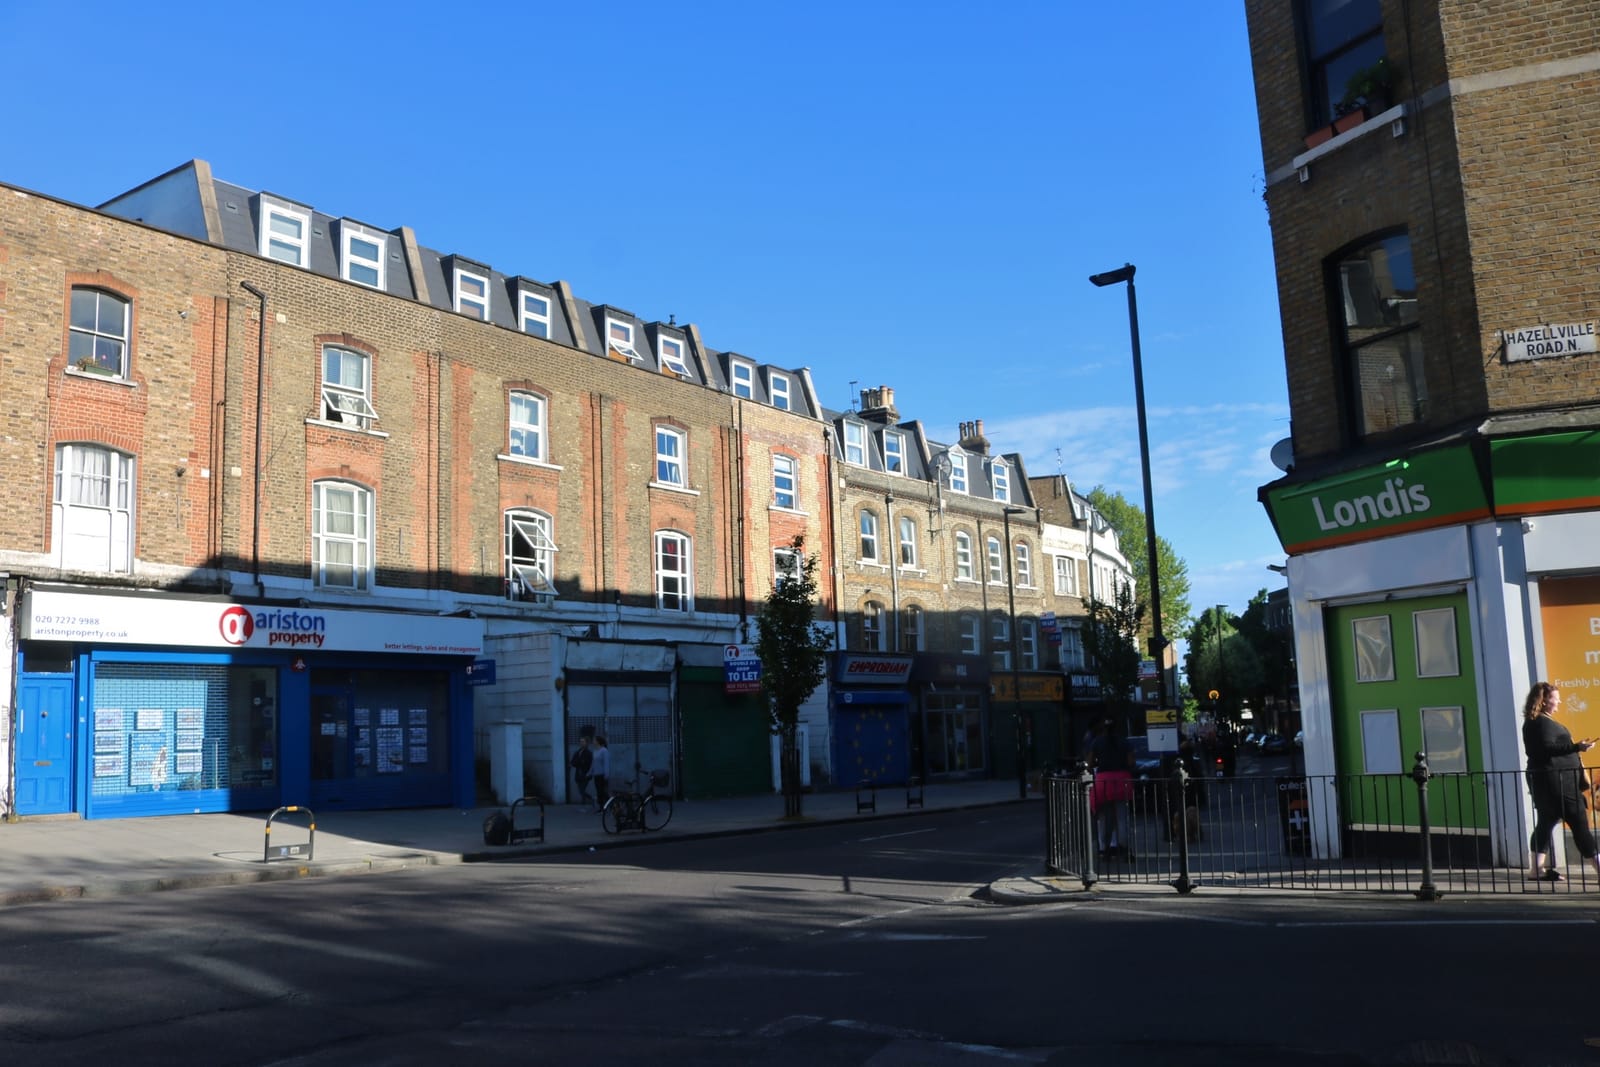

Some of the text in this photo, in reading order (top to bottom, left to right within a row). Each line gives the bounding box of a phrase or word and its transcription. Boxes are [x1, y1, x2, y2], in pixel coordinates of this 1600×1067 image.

[1506, 323, 1594, 345] HAZELLVILLE
[1311, 476, 1431, 531] Londis
[35, 615, 100, 625] 020 7272 9988
[255, 609, 325, 631] ariston
[35, 627, 128, 638] aristonproperty.co.uk
[269, 631, 325, 647] property
[728, 671, 758, 682] TO LET
[1554, 678, 1590, 688] Freshly
